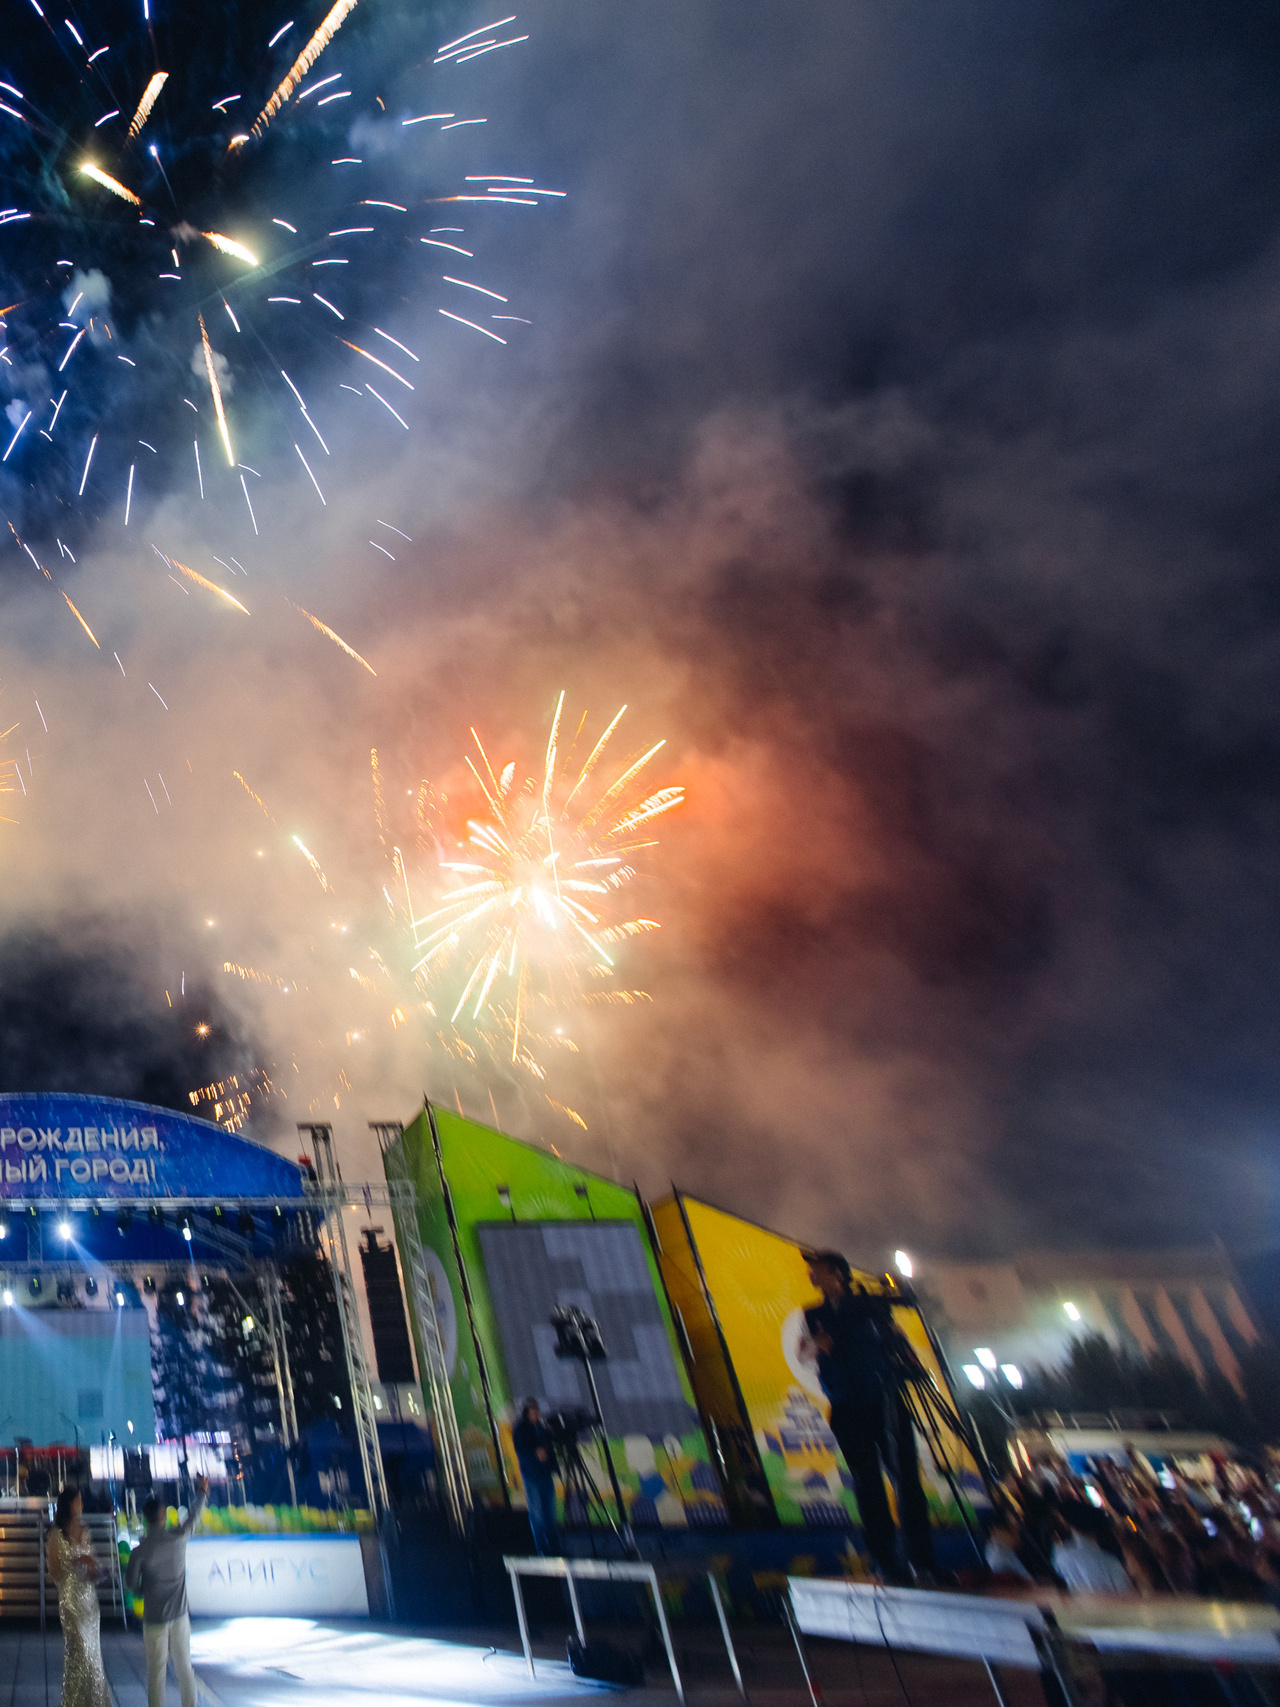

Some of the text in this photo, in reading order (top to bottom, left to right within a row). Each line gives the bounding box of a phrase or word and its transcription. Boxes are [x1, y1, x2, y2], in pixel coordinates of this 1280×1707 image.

[1, 1127, 166, 1155] РОЖДЕНИЯ,
[55, 1158, 157, 1186] ГОРОД!
[208, 1556, 327, 1587] АРИГУС
